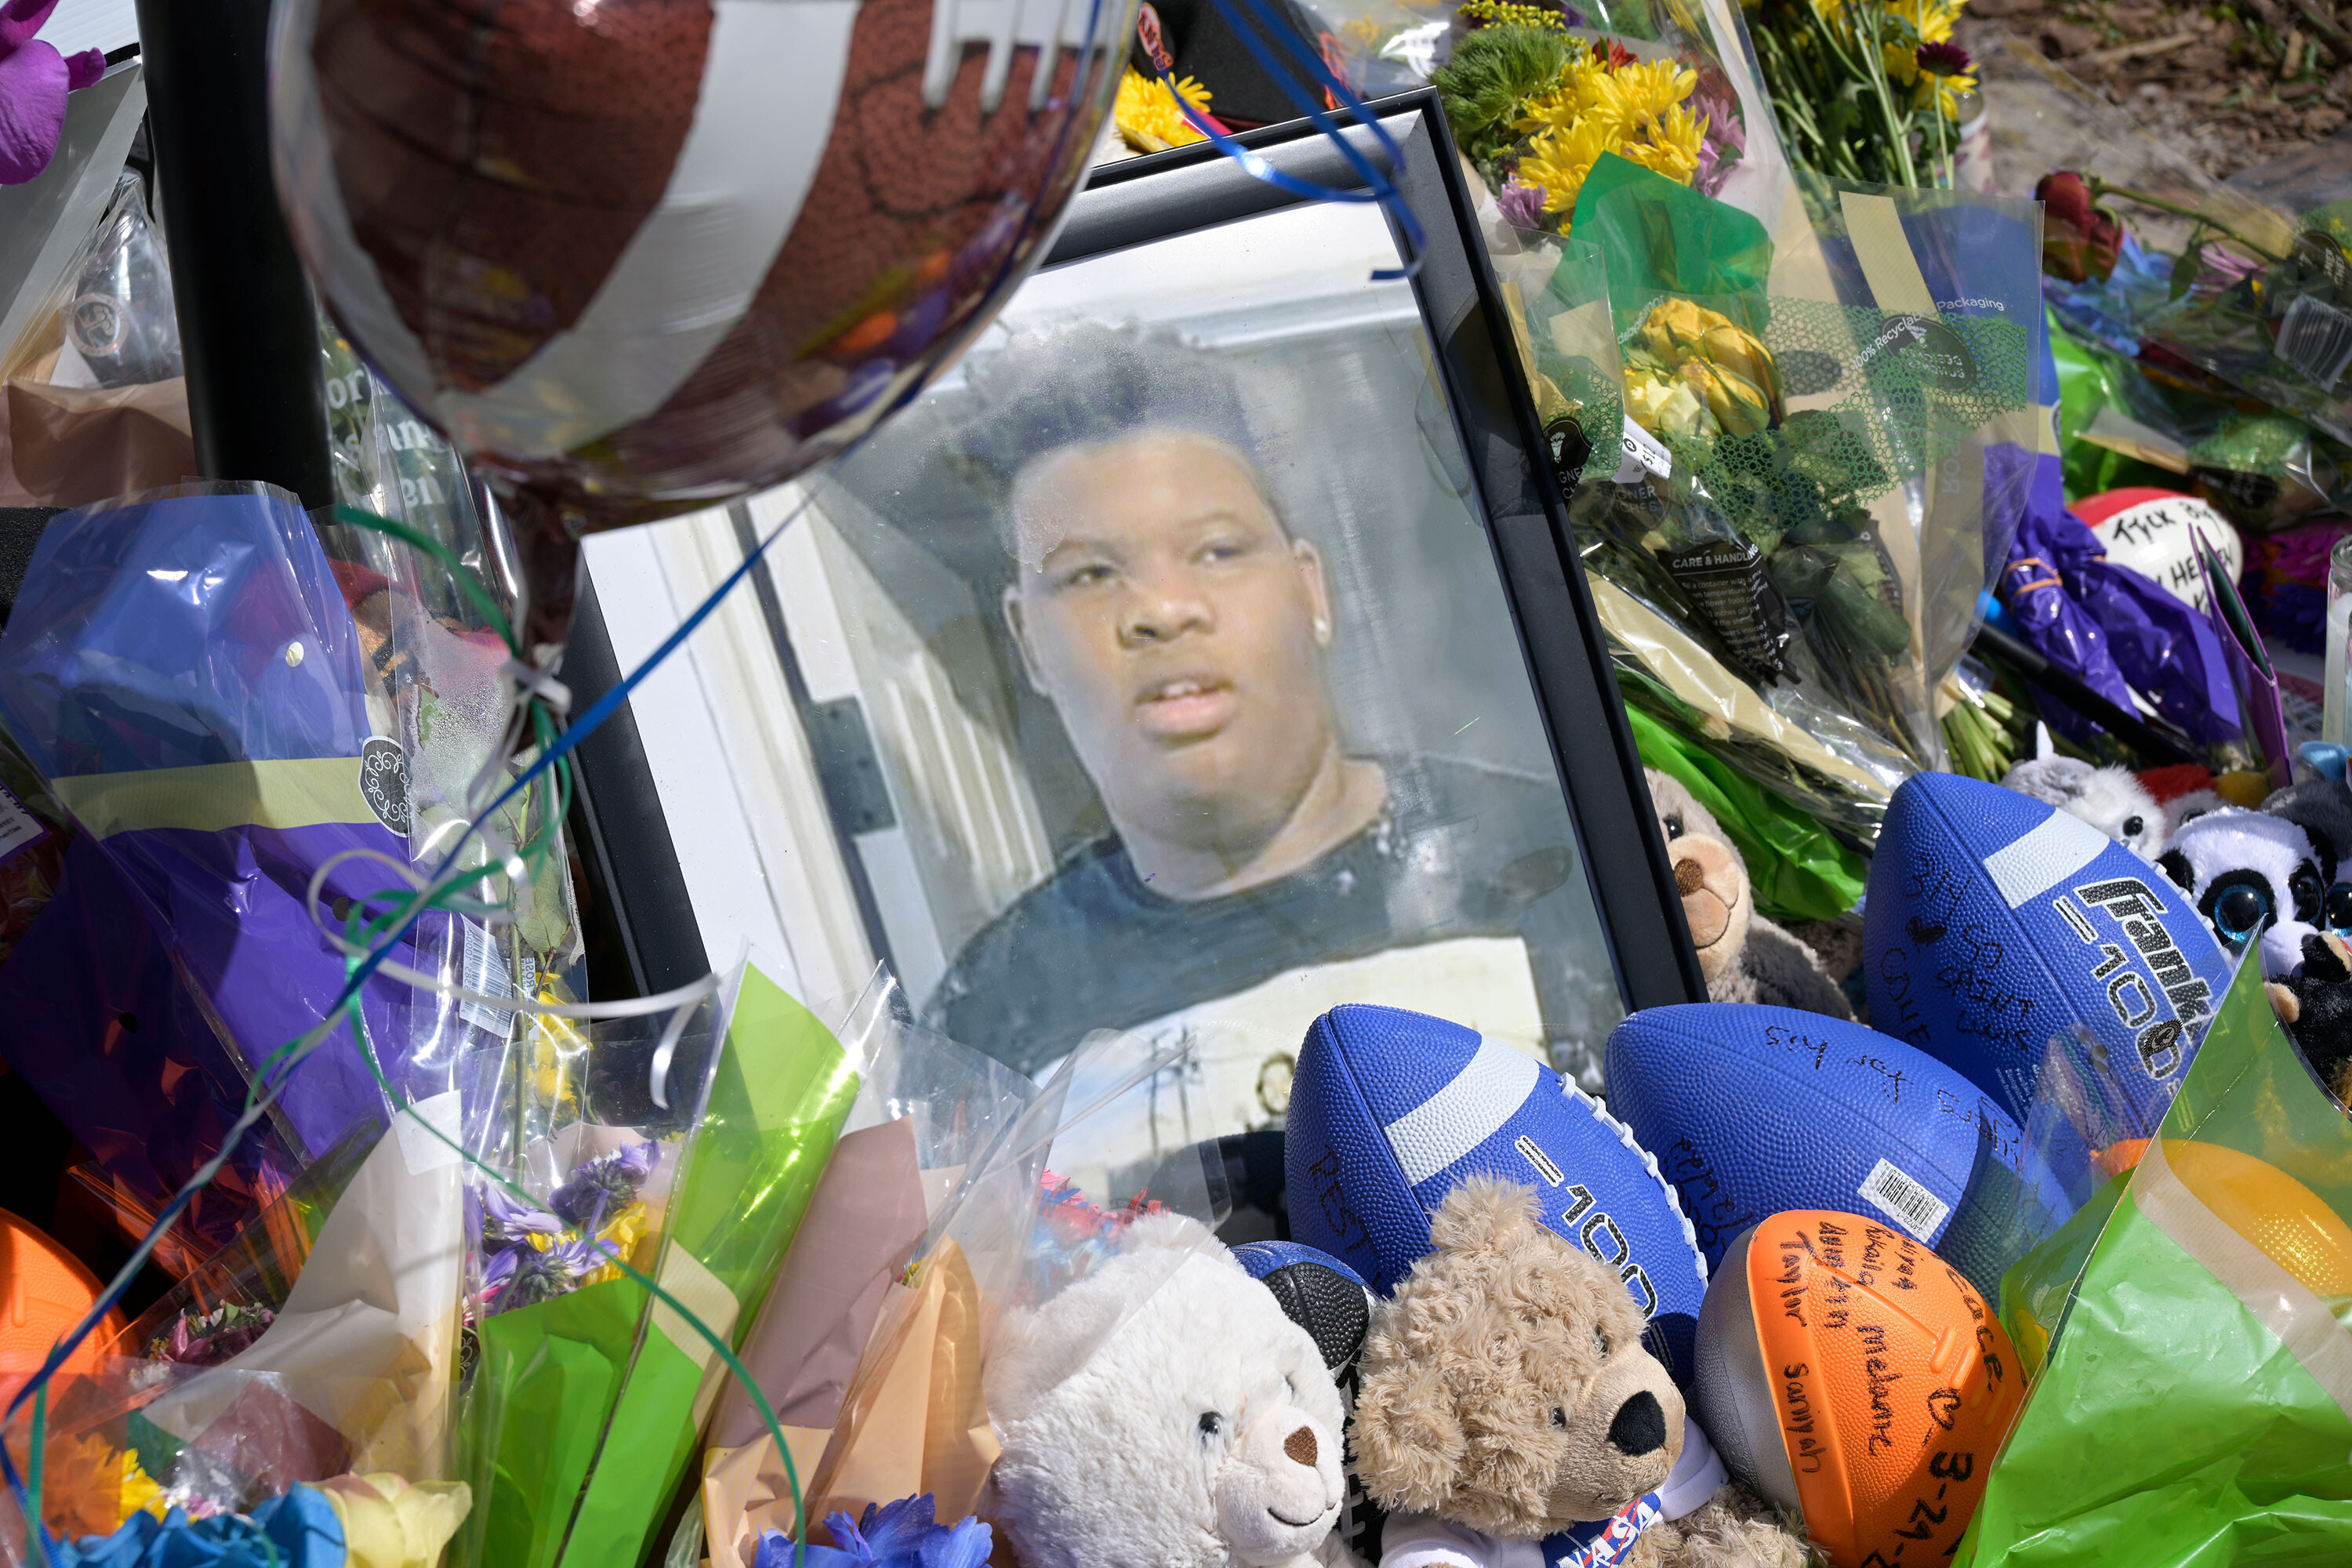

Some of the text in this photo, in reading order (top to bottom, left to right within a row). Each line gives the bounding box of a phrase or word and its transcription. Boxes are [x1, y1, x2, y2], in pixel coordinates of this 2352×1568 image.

[1851, 343, 1876, 371] 100%
[1936, 297, 2005, 312] Packaging
[1672, 543, 1759, 569] CARE & HANDLING
[1697, 579, 1730, 590] container
[1703, 587, 1745, 601] temperature
[2073, 876, 2213, 1049] Frank
[2089, 943, 2183, 1080] 100
[1765, 1024, 1829, 1070] his
[1307, 1143, 1379, 1256] REST
[1896, 1211, 1923, 1234] 34022-1
[1561, 1184, 1658, 1321] 100
[1775, 1230, 1817, 1327] Taylor
[1555, 1501, 1655, 1568] NASA
